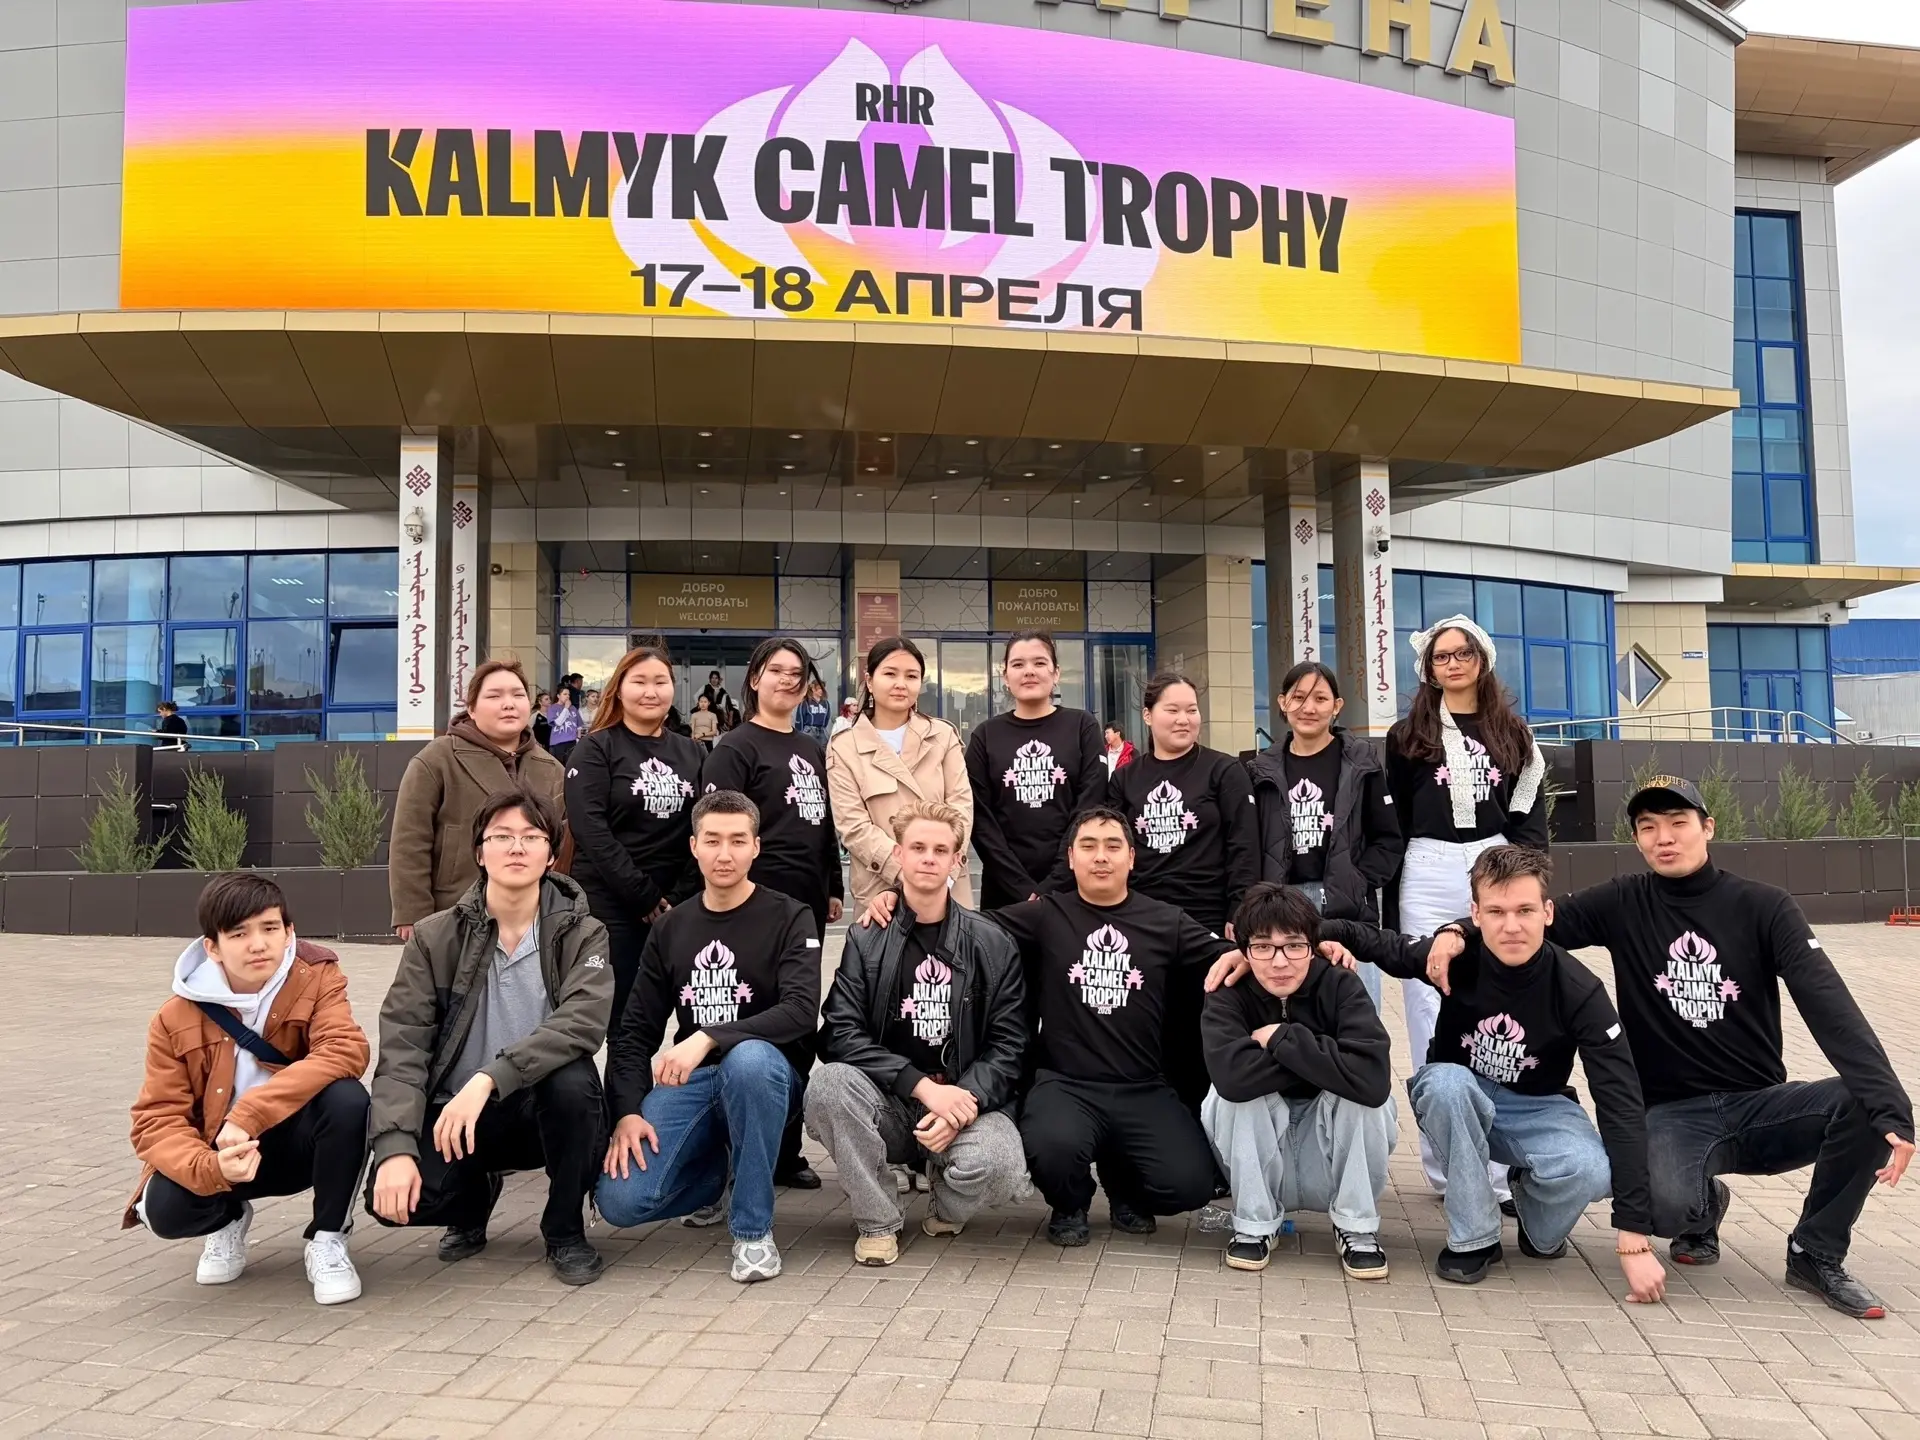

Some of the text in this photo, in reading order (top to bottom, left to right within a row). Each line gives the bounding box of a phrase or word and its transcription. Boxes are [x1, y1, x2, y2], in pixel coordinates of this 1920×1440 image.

[856, 82, 934, 125] RHR
[366, 128, 1348, 274] KALMYK CAMEL TROPHY
[834, 269, 1143, 331] АПРЕЛЯ
[681, 583, 725, 594] ДОБРО
[1018, 588, 1058, 598] ДОБРО
[658, 596, 748, 608] ПОЖАЛОВАТЬ!
[997, 601, 1079, 612] ПОЖАЛОВАТЬ!
[679, 612, 729, 622] WELCOME!
[1016, 617, 1061, 625] WELCOME!
[1013, 756, 1054, 771] KALMYK
[641, 771, 682, 784] KALMYK
[792, 774, 823, 788] KALMYK
[1018, 770, 1051, 785] CAMEL
[648, 783, 680, 796] CAMEL
[799, 788, 823, 802] CAMEL
[1014, 785, 1055, 801] TROPHY
[644, 796, 684, 812] TROPHY
[1144, 801, 1185, 819] KALMYK
[1290, 801, 1324, 817] ALMYK
[1148, 816, 1181, 833] CAMEL
[1291, 816, 1320, 832] AMEL
[1146, 831, 1186, 848] TROPHY
[1082, 949, 1131, 972] KALMYK
[691, 969, 738, 987] KALMYK
[1086, 968, 1125, 988] CAMEL
[1667, 960, 1722, 984] KALMYK
[696, 987, 734, 1005] CAMEL
[1081, 985, 1129, 1007] TROPHY
[1673, 980, 1719, 1001] CAMEL
[691, 1004, 739, 1024] TROPHY
[917, 1002, 951, 1019] CAMEL
[1669, 997, 1726, 1019] TROPHY
[1473, 1029, 1527, 1059] KALMYK
[1476, 1045, 1517, 1071] CAMEL
[1470, 1054, 1522, 1083] TROPHY
